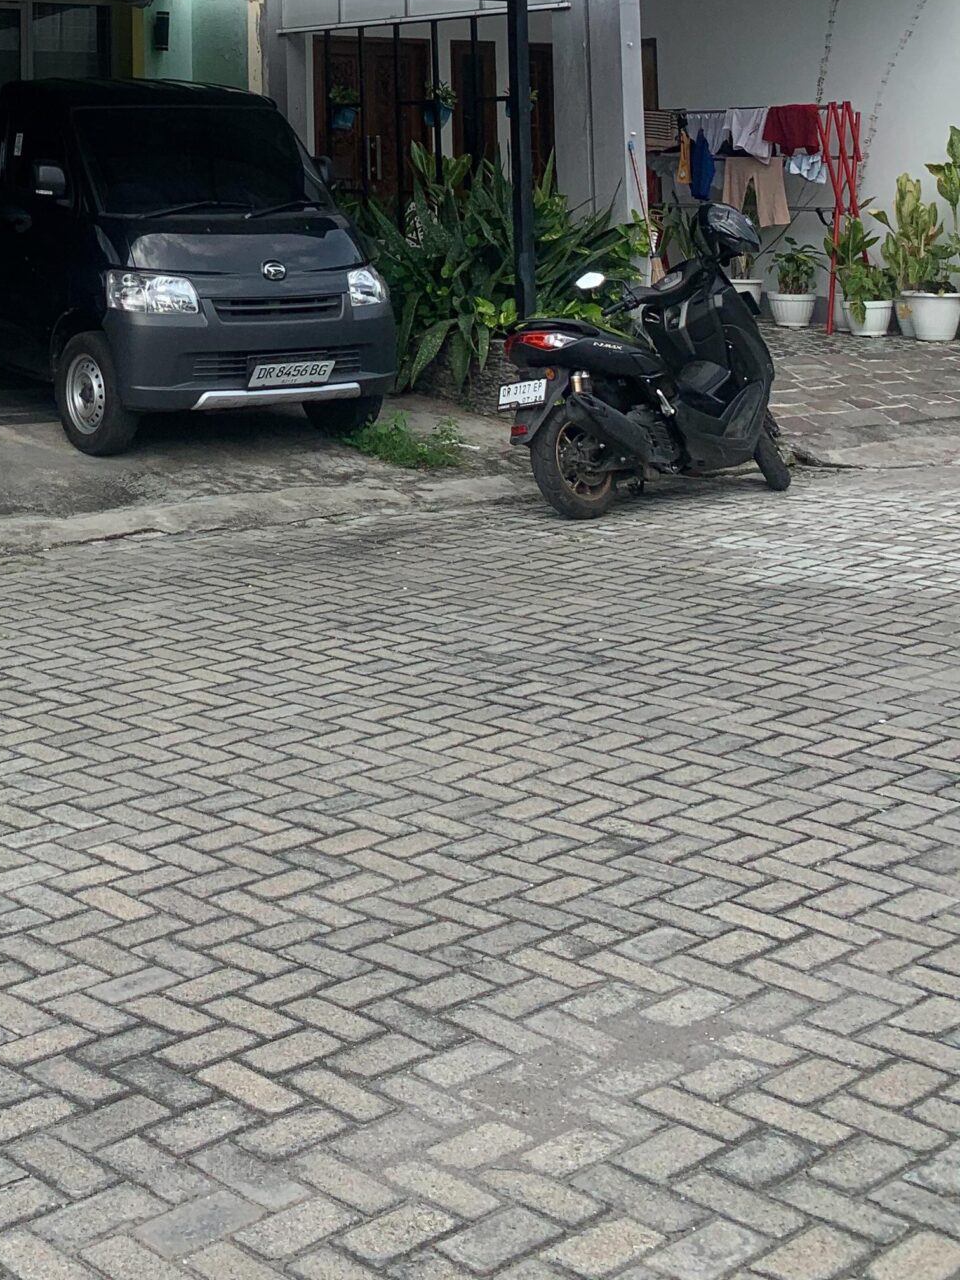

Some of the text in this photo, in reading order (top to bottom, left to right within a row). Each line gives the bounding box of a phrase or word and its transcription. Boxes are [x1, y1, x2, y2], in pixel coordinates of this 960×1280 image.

[593, 341, 623, 351] NMAX
[256, 363, 329, 380] DR 8456 BG
[502, 381, 542, 397] DR 3127 EP
